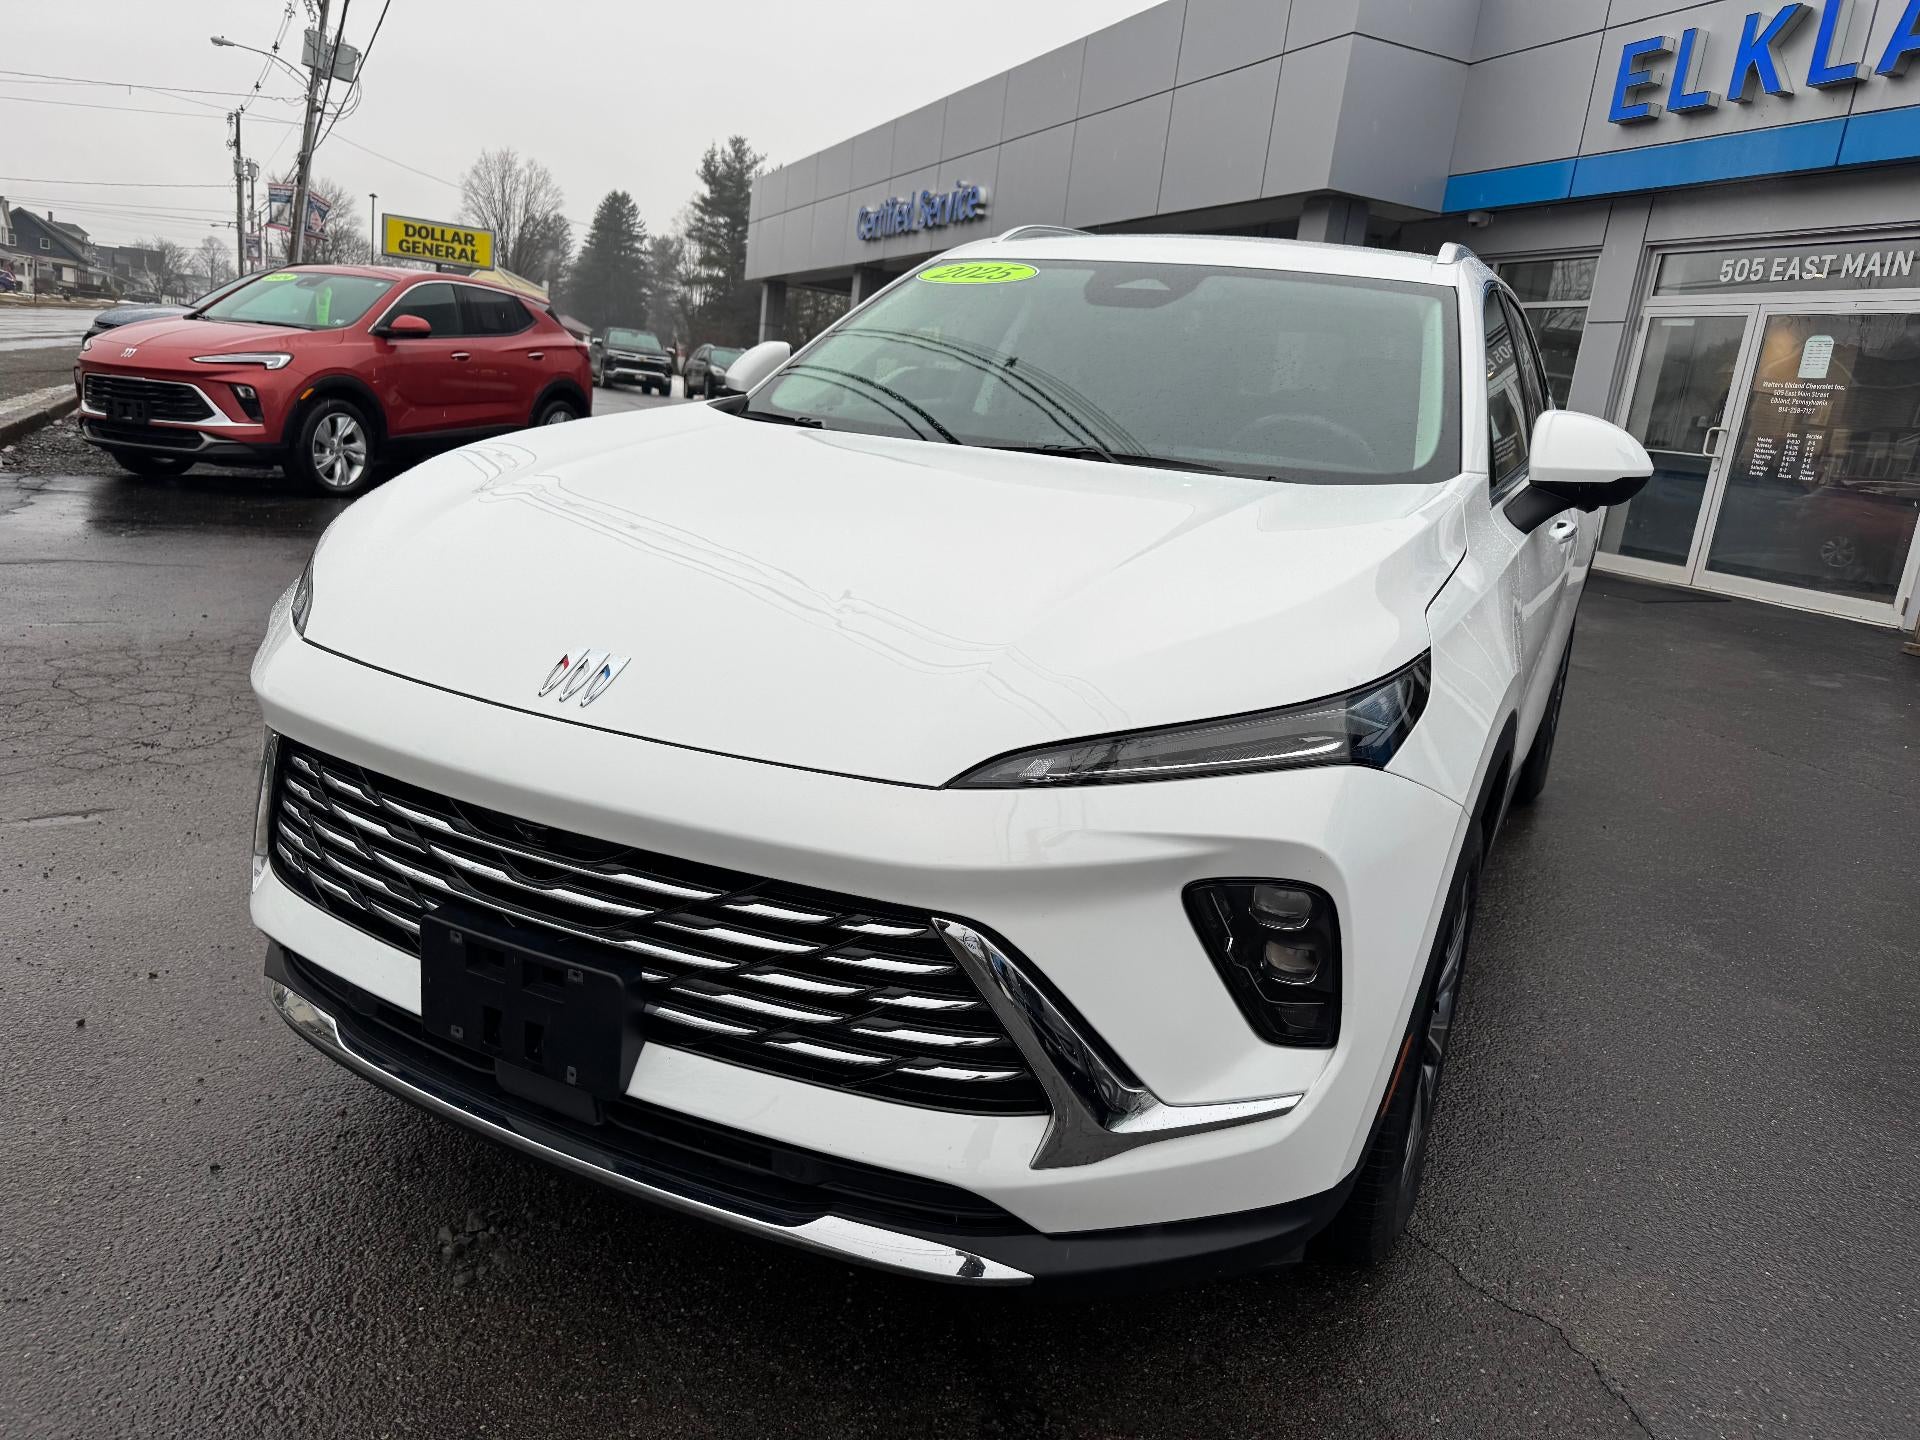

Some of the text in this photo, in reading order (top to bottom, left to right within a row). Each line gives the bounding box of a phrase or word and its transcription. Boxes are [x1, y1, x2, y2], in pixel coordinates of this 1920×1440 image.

[856, 180, 983, 240] Certified Service
[403, 223, 476, 248] DOLLAR
[398, 238, 480, 263] GENERAL
[931, 265, 1026, 280] 2025
[1719, 250, 1915, 282] 505 EAST MAIN
[1791, 398, 1828, 406] Pennsylvania
